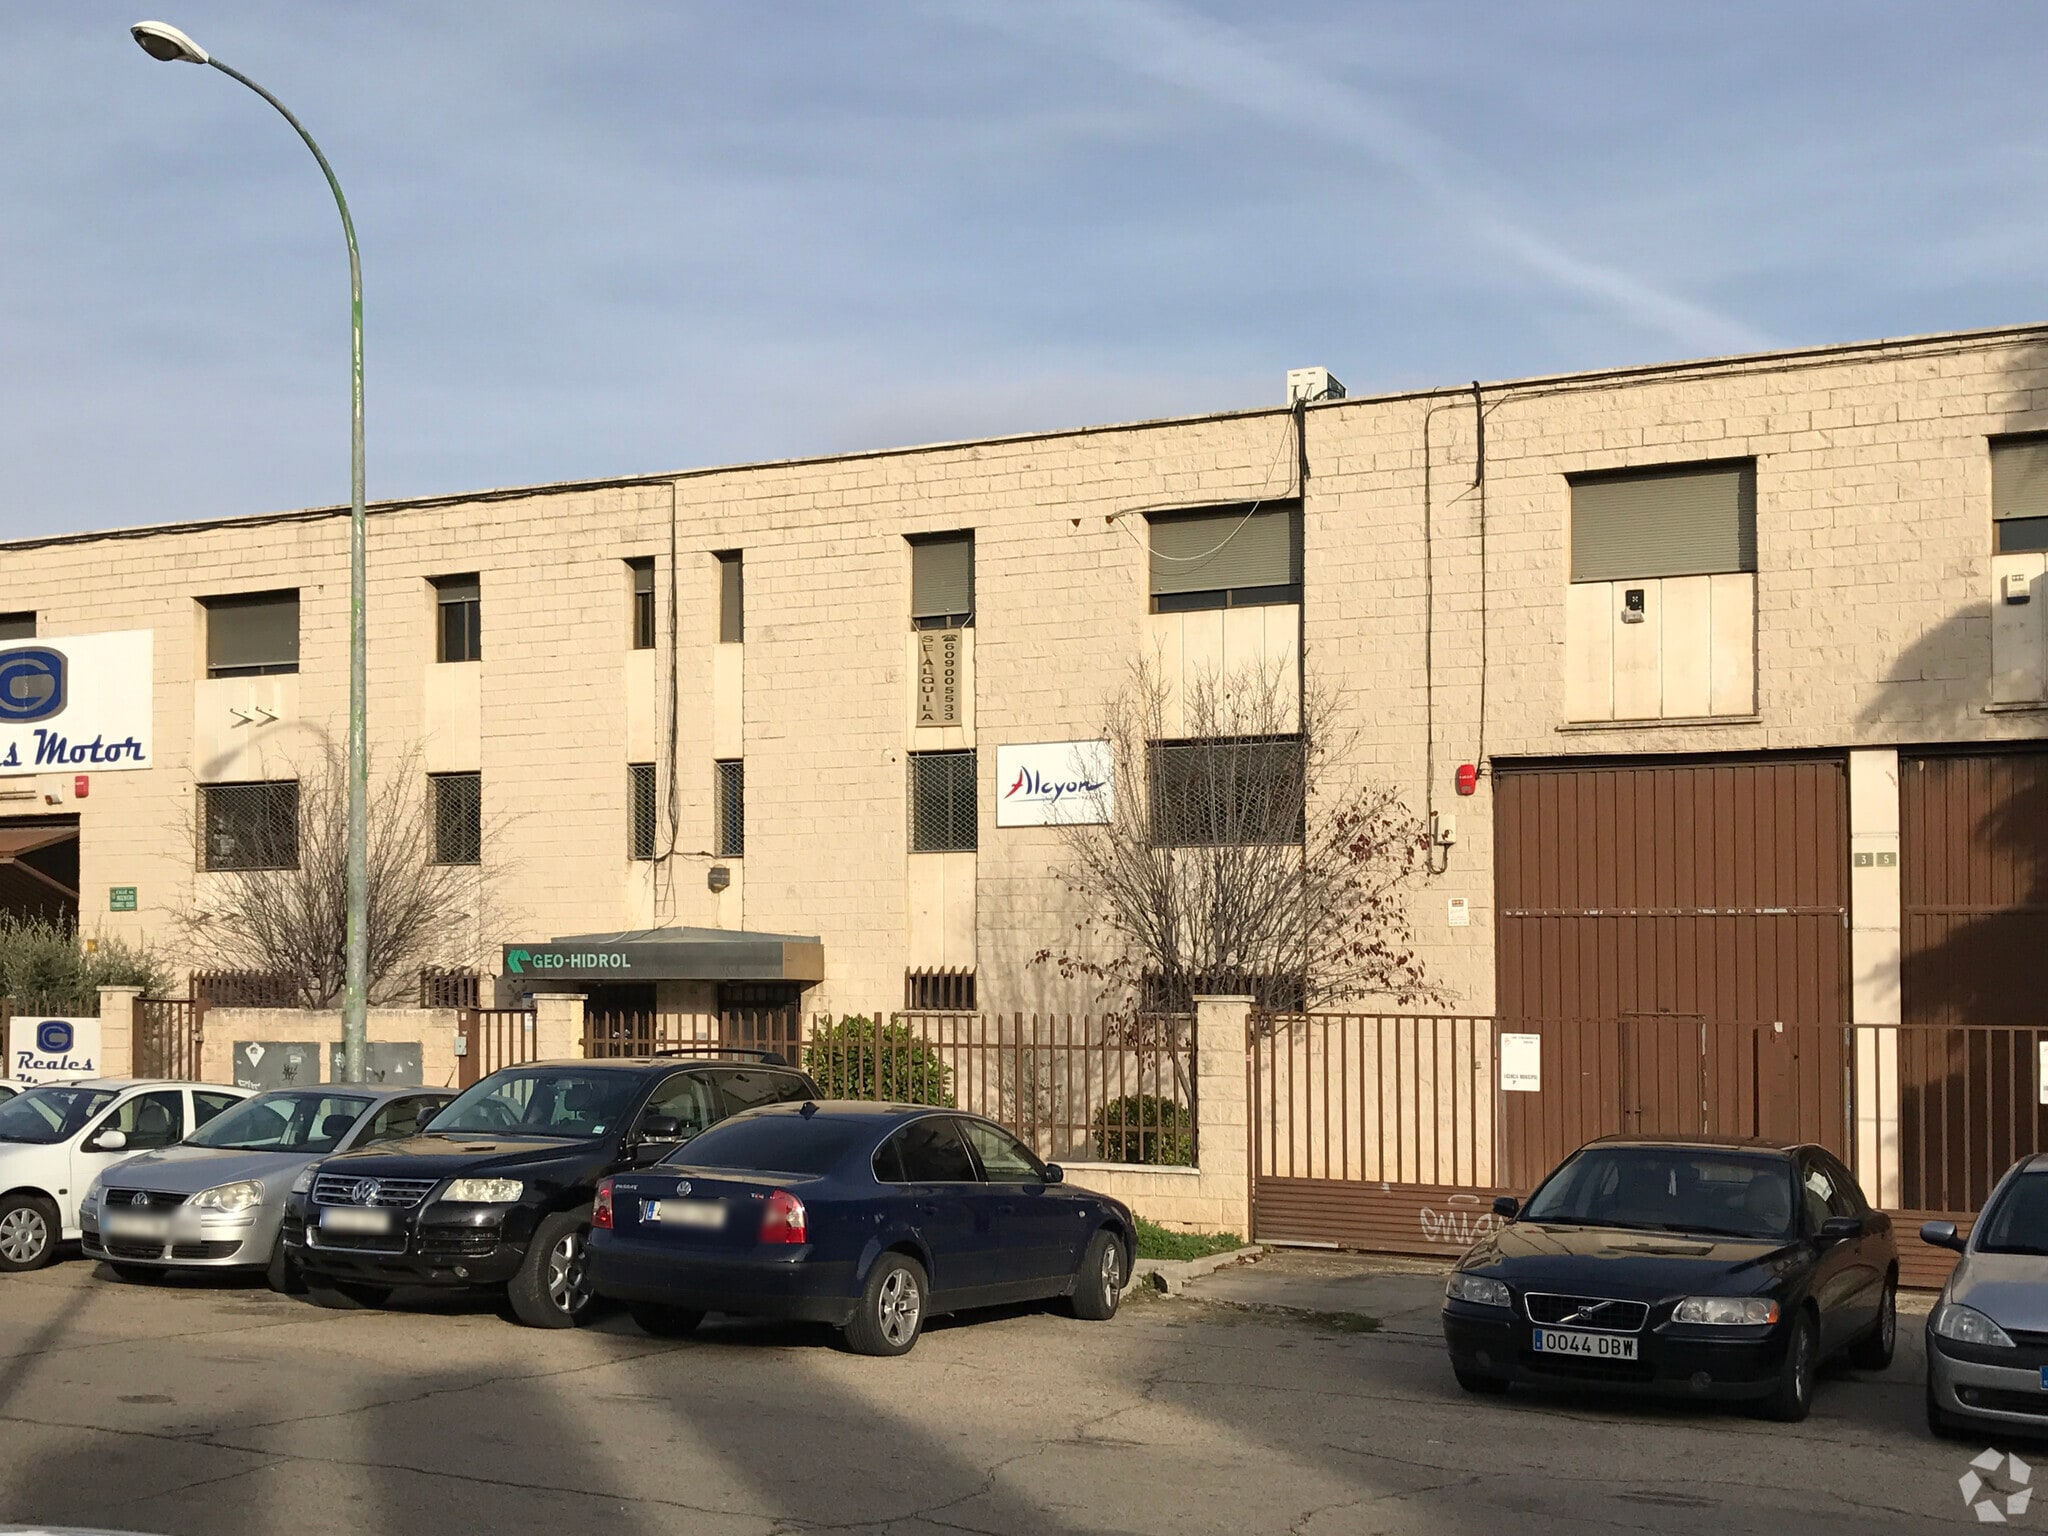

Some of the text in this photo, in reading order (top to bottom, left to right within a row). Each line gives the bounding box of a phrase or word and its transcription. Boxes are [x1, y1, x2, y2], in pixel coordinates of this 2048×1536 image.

[921, 635, 935, 721] SE ALQUILA
[944, 642, 955, 721] 609005533
[33, 728, 146, 765] Motor
[1003, 765, 1106, 804] Alcyon
[1861, 855, 1867, 865] 3
[1883, 854, 1890, 864] 5
[532, 953, 631, 969] GEO-HIDROL
[16, 1051, 95, 1071] Reales
[1546, 1333, 1633, 1357] 0044 DBW
